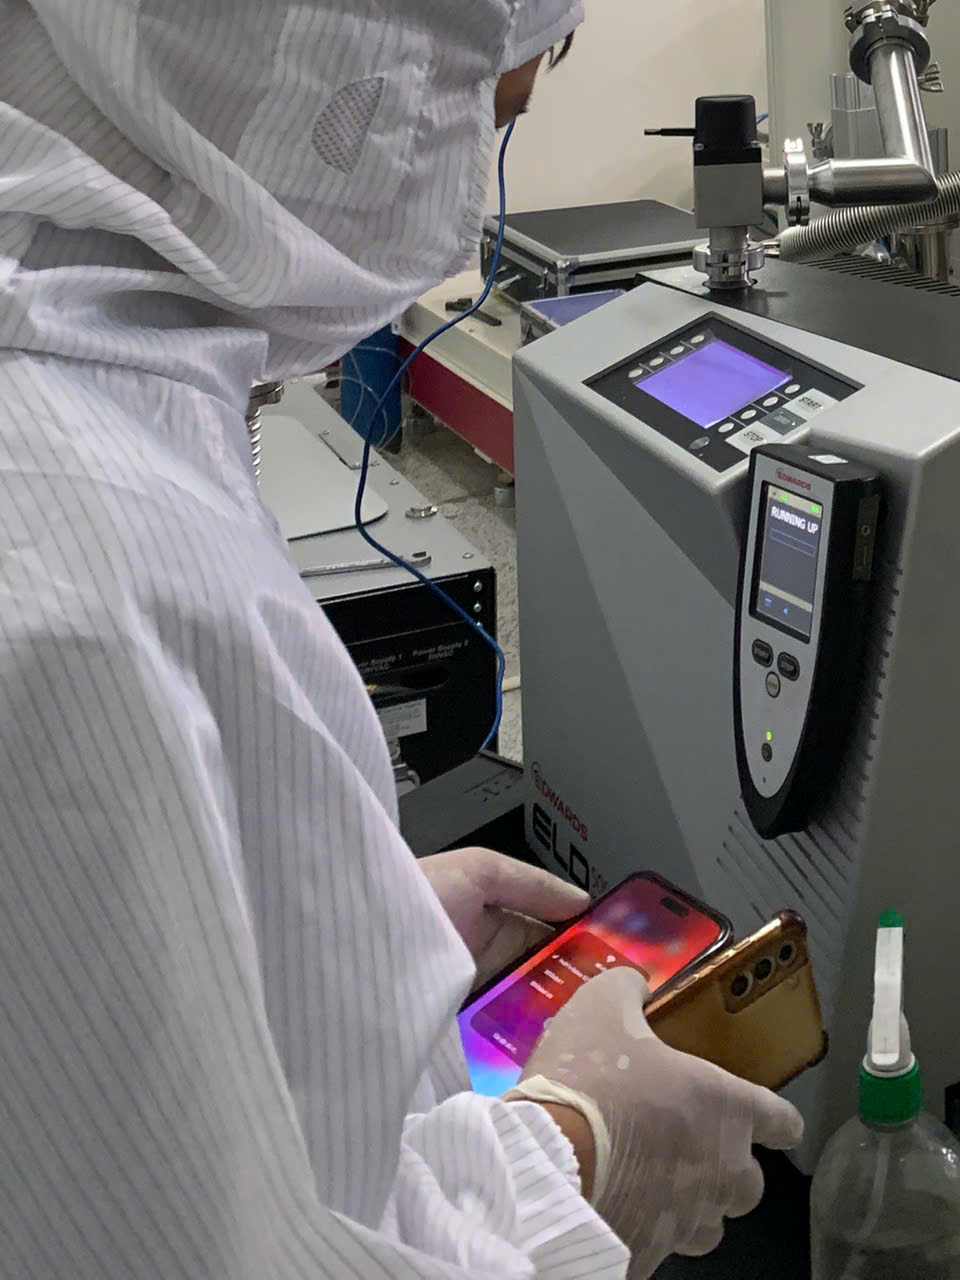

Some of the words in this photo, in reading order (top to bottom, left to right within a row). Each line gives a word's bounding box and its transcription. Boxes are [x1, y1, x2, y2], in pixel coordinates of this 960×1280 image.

[743, 431, 764, 442] STOP
[777, 468, 811, 491] EDWARDS
[771, 506, 806, 530] RUNNING
[807, 520, 819, 534] UP
[535, 774, 589, 841] EDWARDS
[532, 803, 590, 893] ELD
